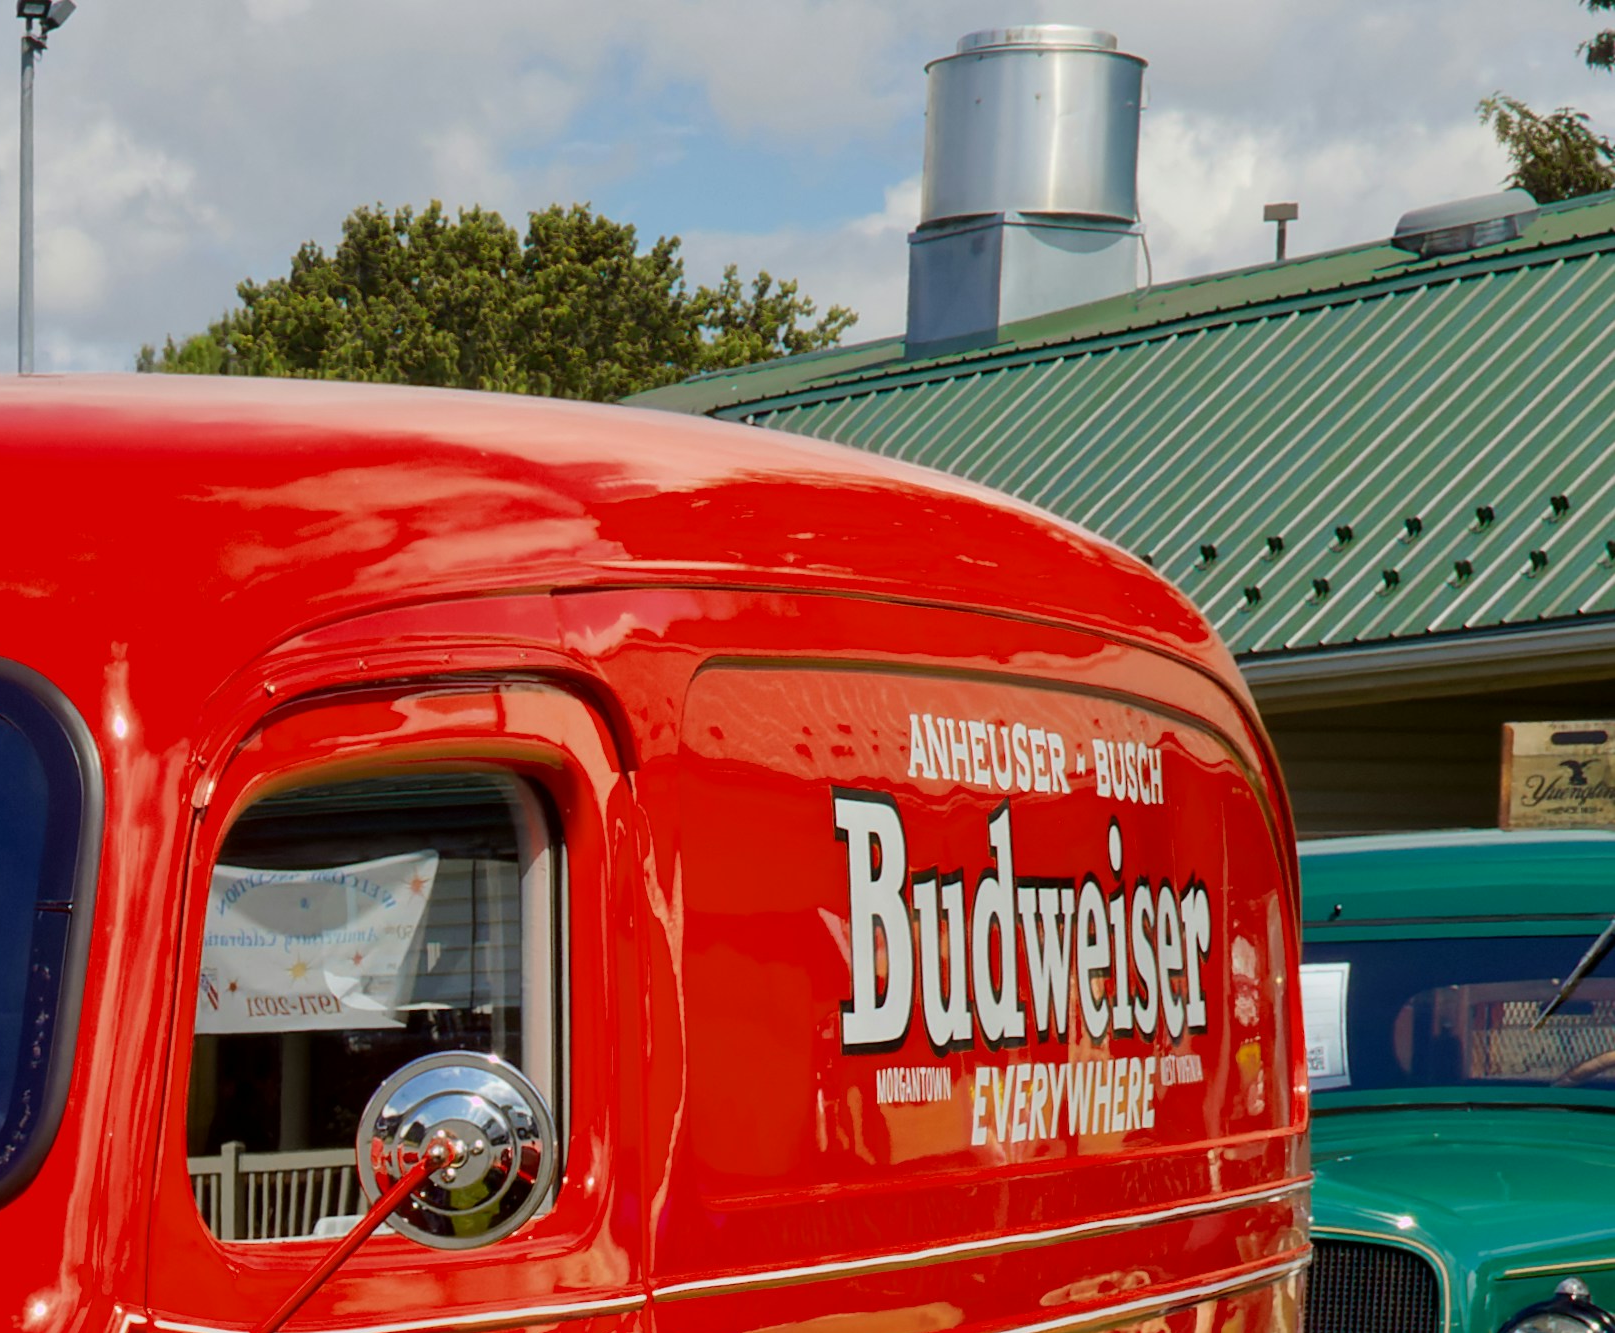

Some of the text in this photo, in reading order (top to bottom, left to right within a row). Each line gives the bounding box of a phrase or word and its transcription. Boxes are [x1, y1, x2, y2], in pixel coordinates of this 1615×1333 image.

[907, 713, 1071, 795] ANHEUSER
[1091, 738, 1165, 805] BUSCH
[831, 785, 1212, 1058] Budweiser
[875, 1066, 952, 1104] MORGANTOWN
[971, 1056, 1157, 1147] EVERYWHERE
